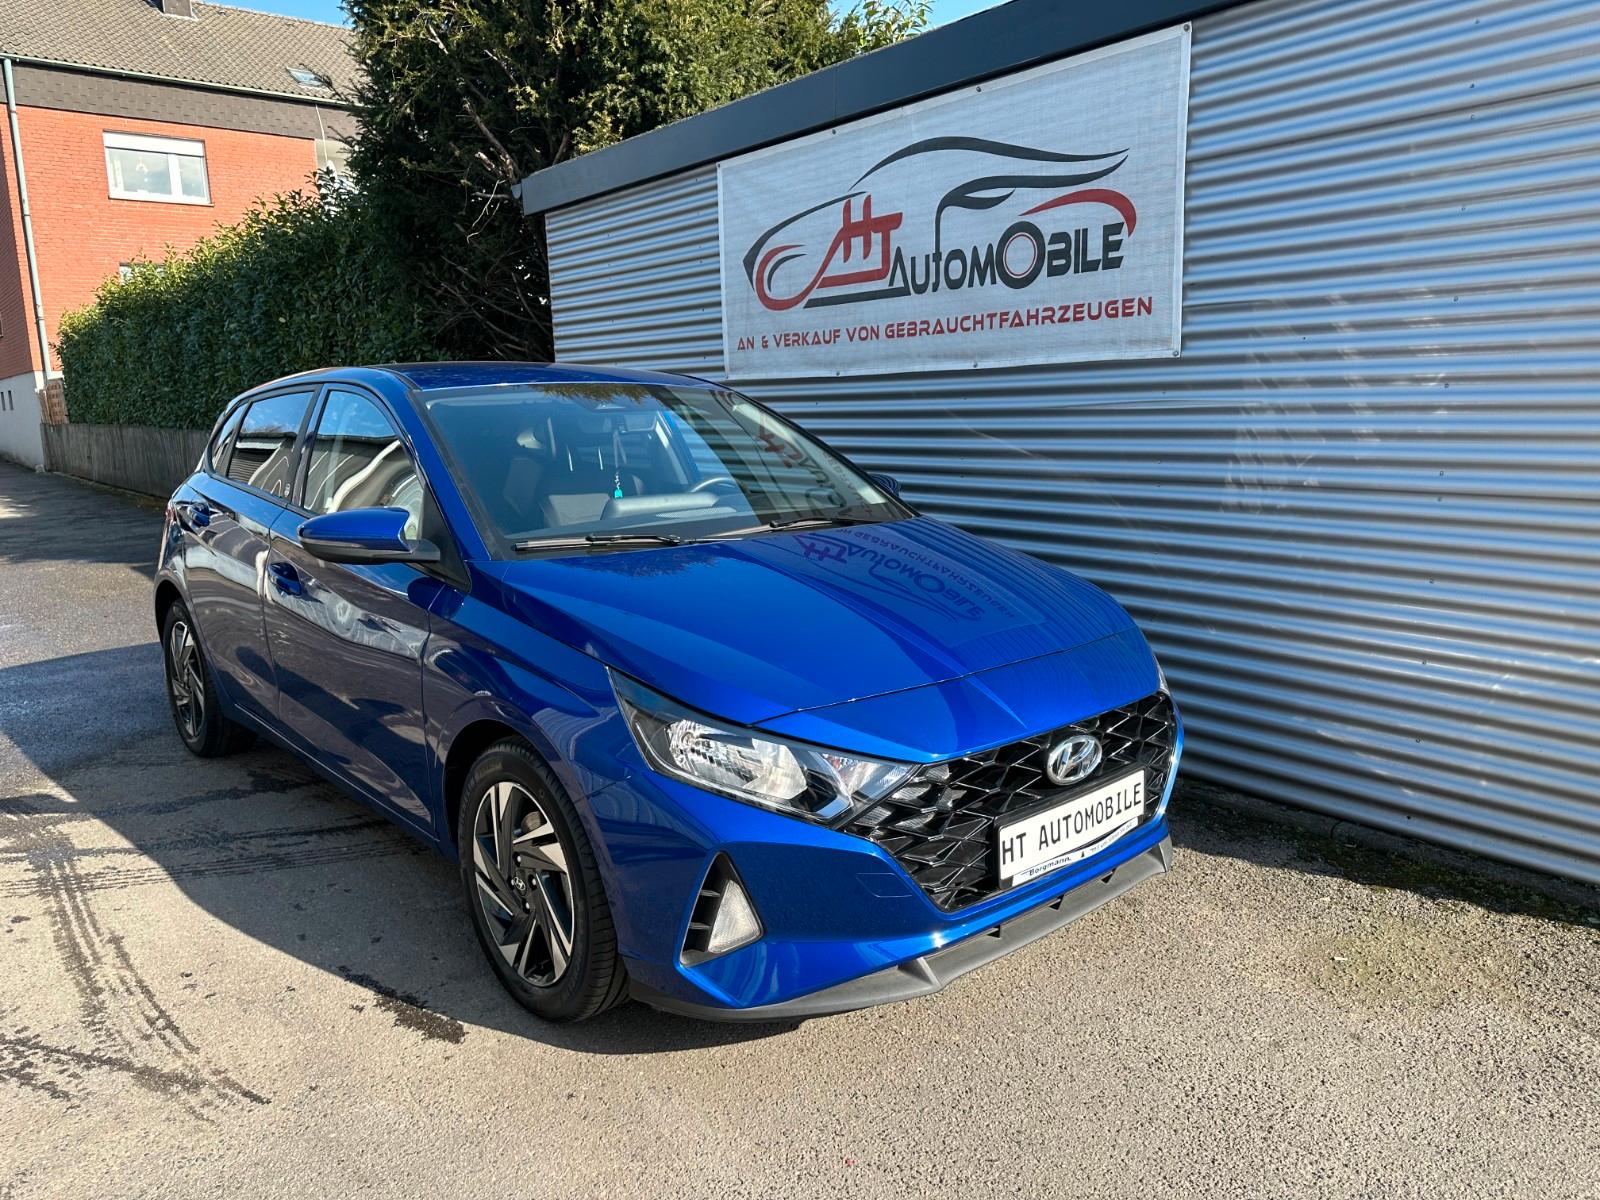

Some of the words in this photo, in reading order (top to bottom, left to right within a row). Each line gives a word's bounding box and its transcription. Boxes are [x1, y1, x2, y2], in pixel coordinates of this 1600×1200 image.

[837, 194, 903, 282] HT
[888, 220, 1125, 296] AUTOMOBILE
[737, 335, 755, 351] AN
[761, 333, 770, 350] &
[774, 328, 842, 348] VERKAUF
[846, 324, 880, 342] VON
[884, 296, 1153, 338] GEBRAUCHTFAHRZEUGEN
[1002, 832, 1027, 865] HT
[1038, 782, 1142, 851] AUTOMOBILE
